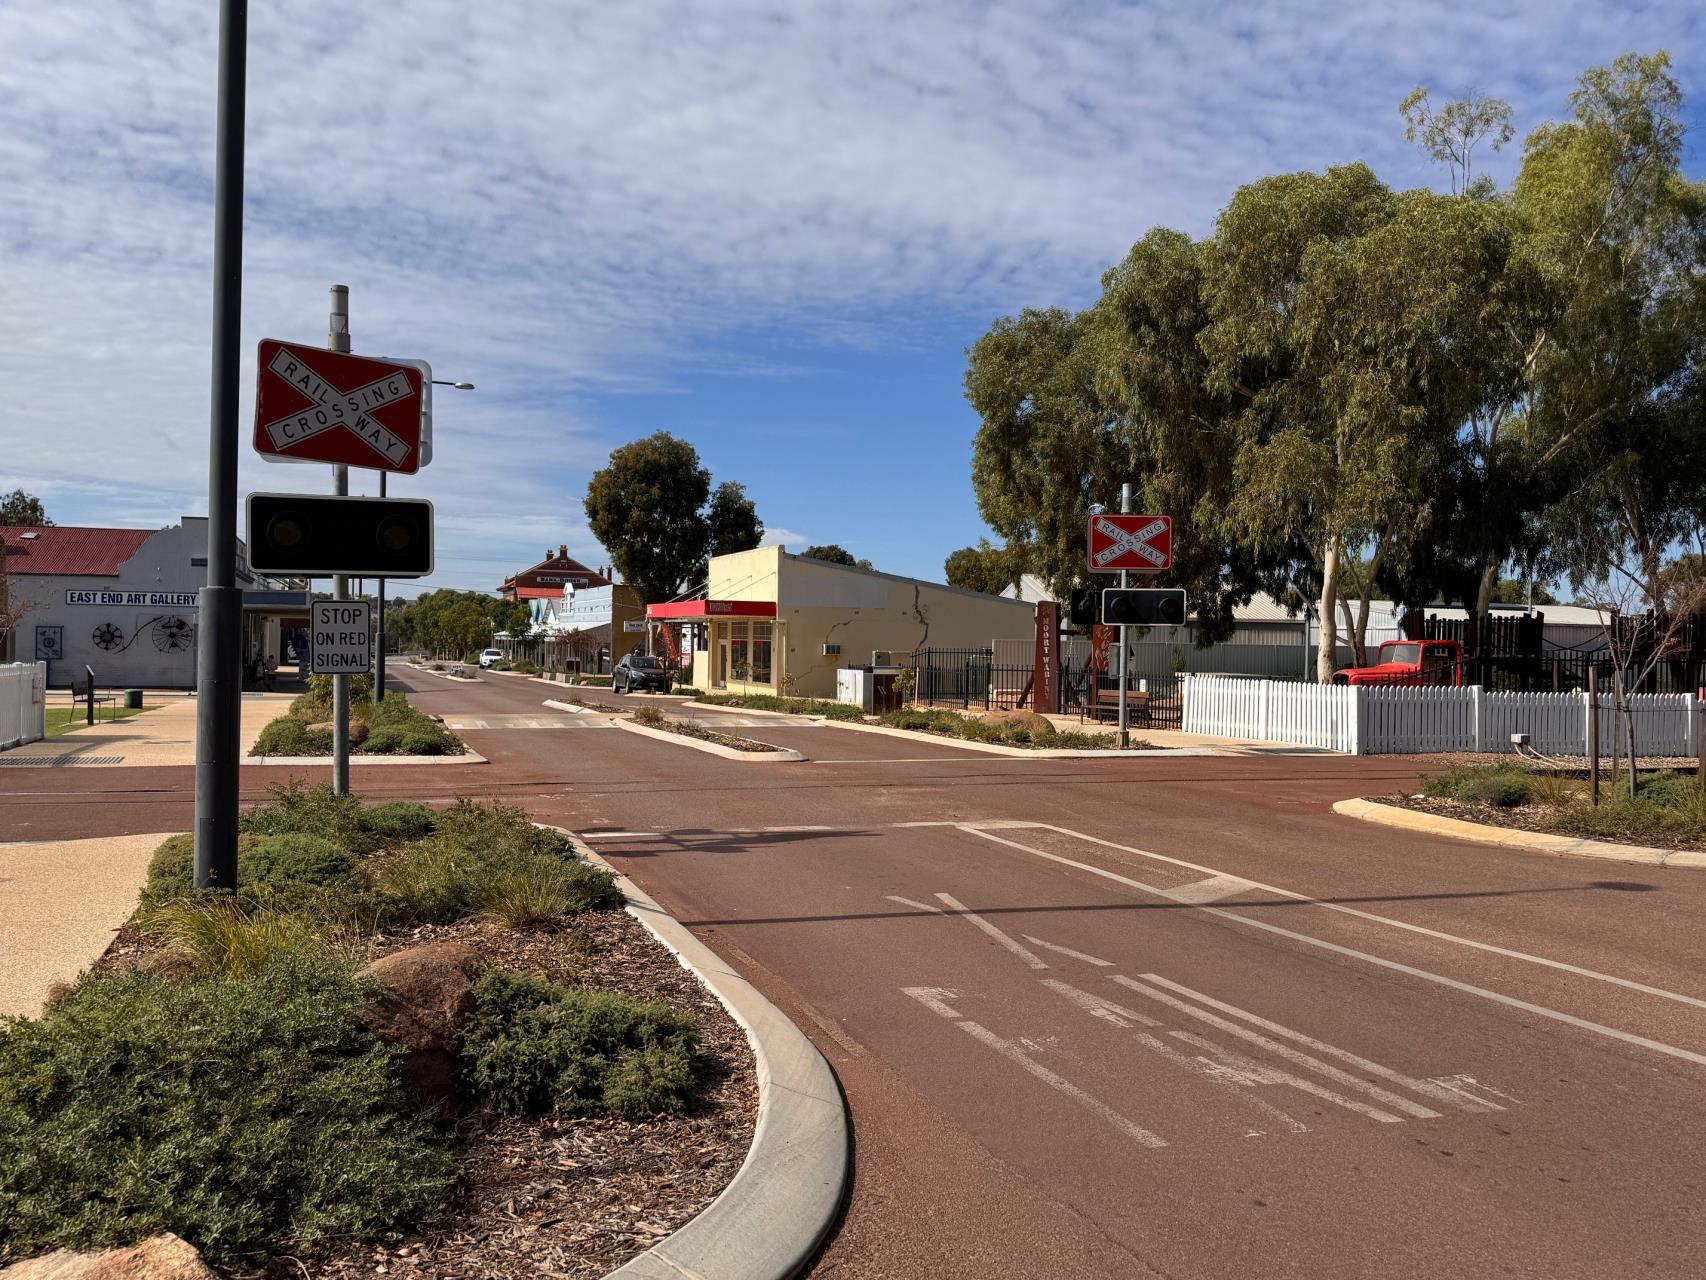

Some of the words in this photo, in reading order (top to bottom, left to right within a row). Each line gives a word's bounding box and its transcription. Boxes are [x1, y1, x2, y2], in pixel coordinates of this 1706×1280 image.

[282, 379, 401, 439] CROSSING
[283, 360, 329, 404] RAIL
[354, 414, 399, 453] WAY
[1100, 523, 1162, 561] CROSSING
[1101, 522, 1124, 541] RAIL
[1140, 545, 1161, 561] WAY
[70, 592, 97, 604] EAST
[101, 593, 123, 604] END
[127, 593, 147, 604] ART
[150, 593, 197, 605] GALLERY
[320, 608, 363, 625] STOP
[316, 632, 336, 647] ON
[340, 633, 367, 647] RED
[316, 652, 368, 667] SIGNAL
